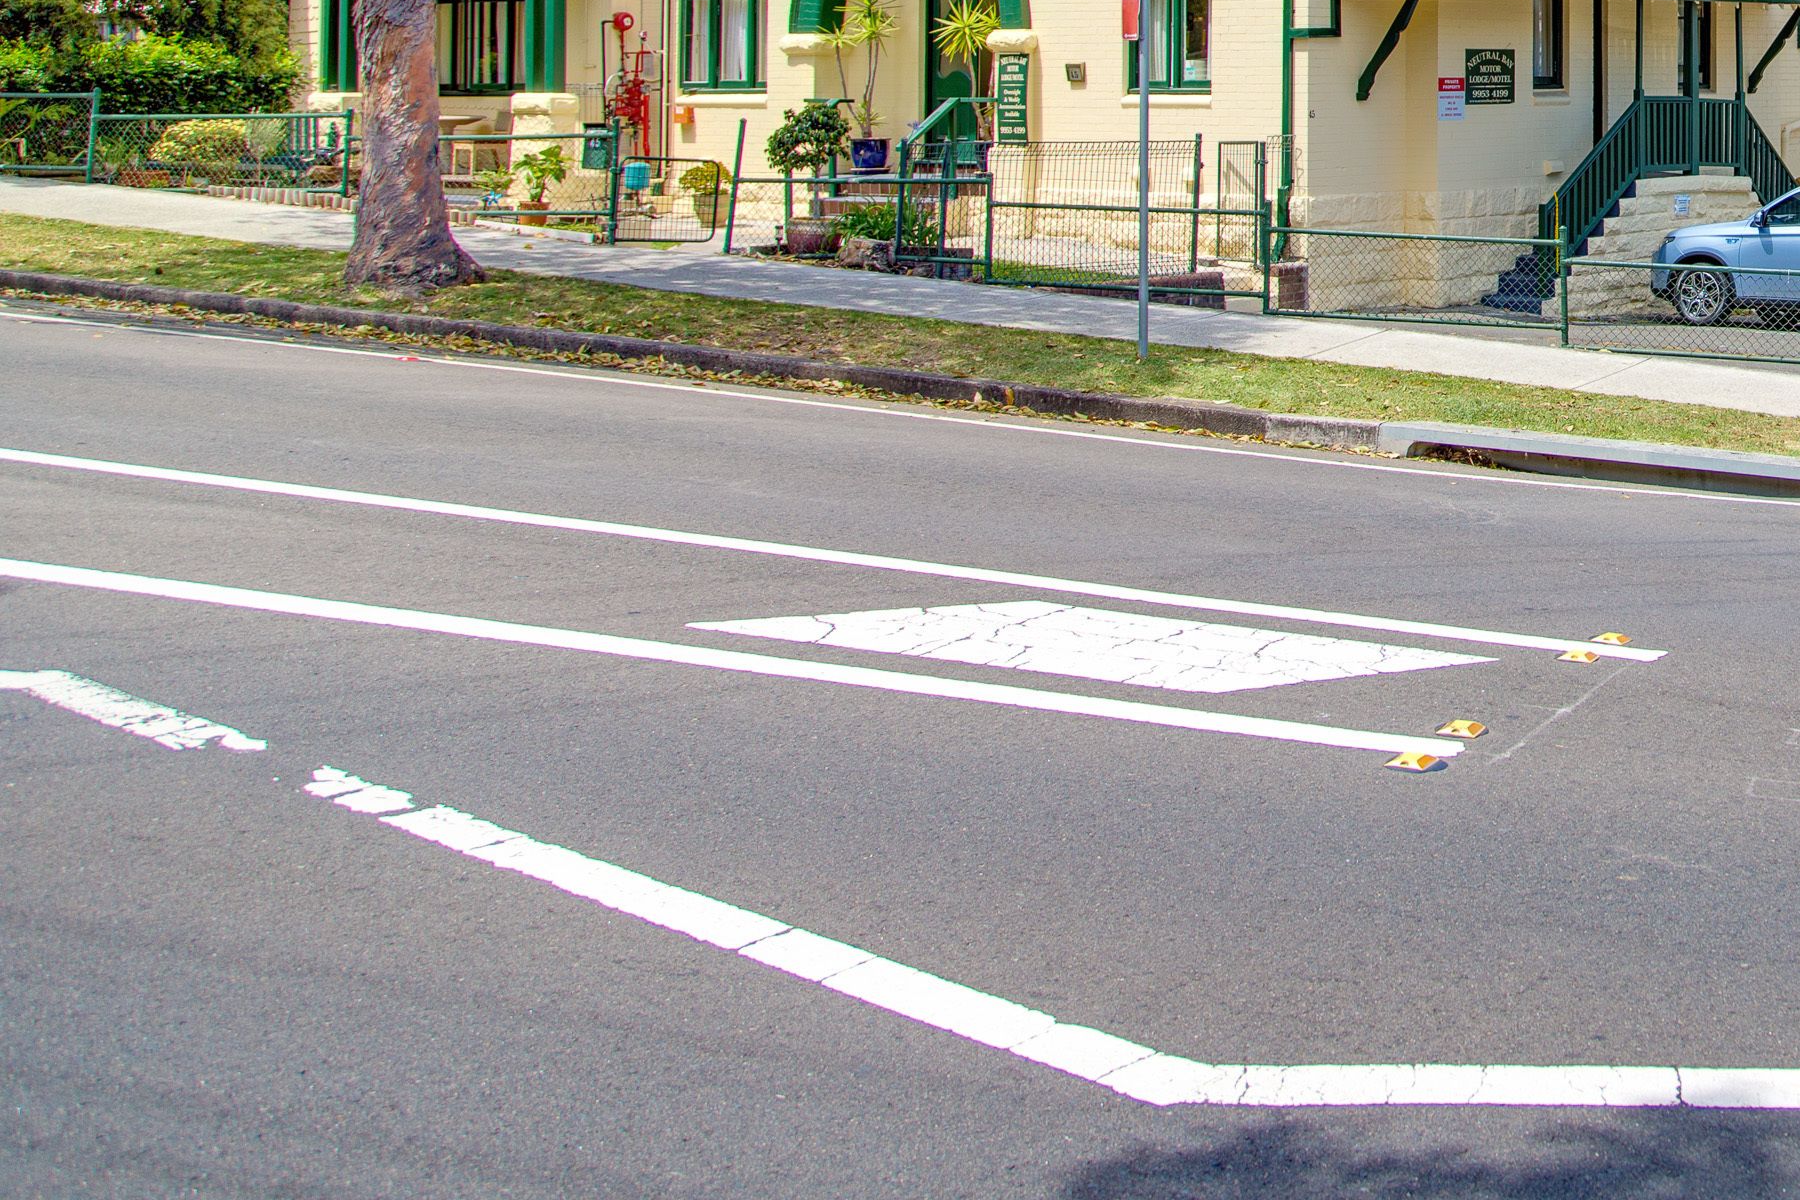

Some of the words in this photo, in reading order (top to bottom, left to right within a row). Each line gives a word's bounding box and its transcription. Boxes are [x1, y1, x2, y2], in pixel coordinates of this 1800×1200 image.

[1467, 51, 1500, 70] NEUTRAL
[1502, 54, 1514, 68] BAY
[1479, 65, 1502, 73] MOTOR
[1469, 75, 1512, 83] LODGE/MOTEL
[1472, 90, 1490, 98] 9953
[1491, 89, 1509, 98] 4199
